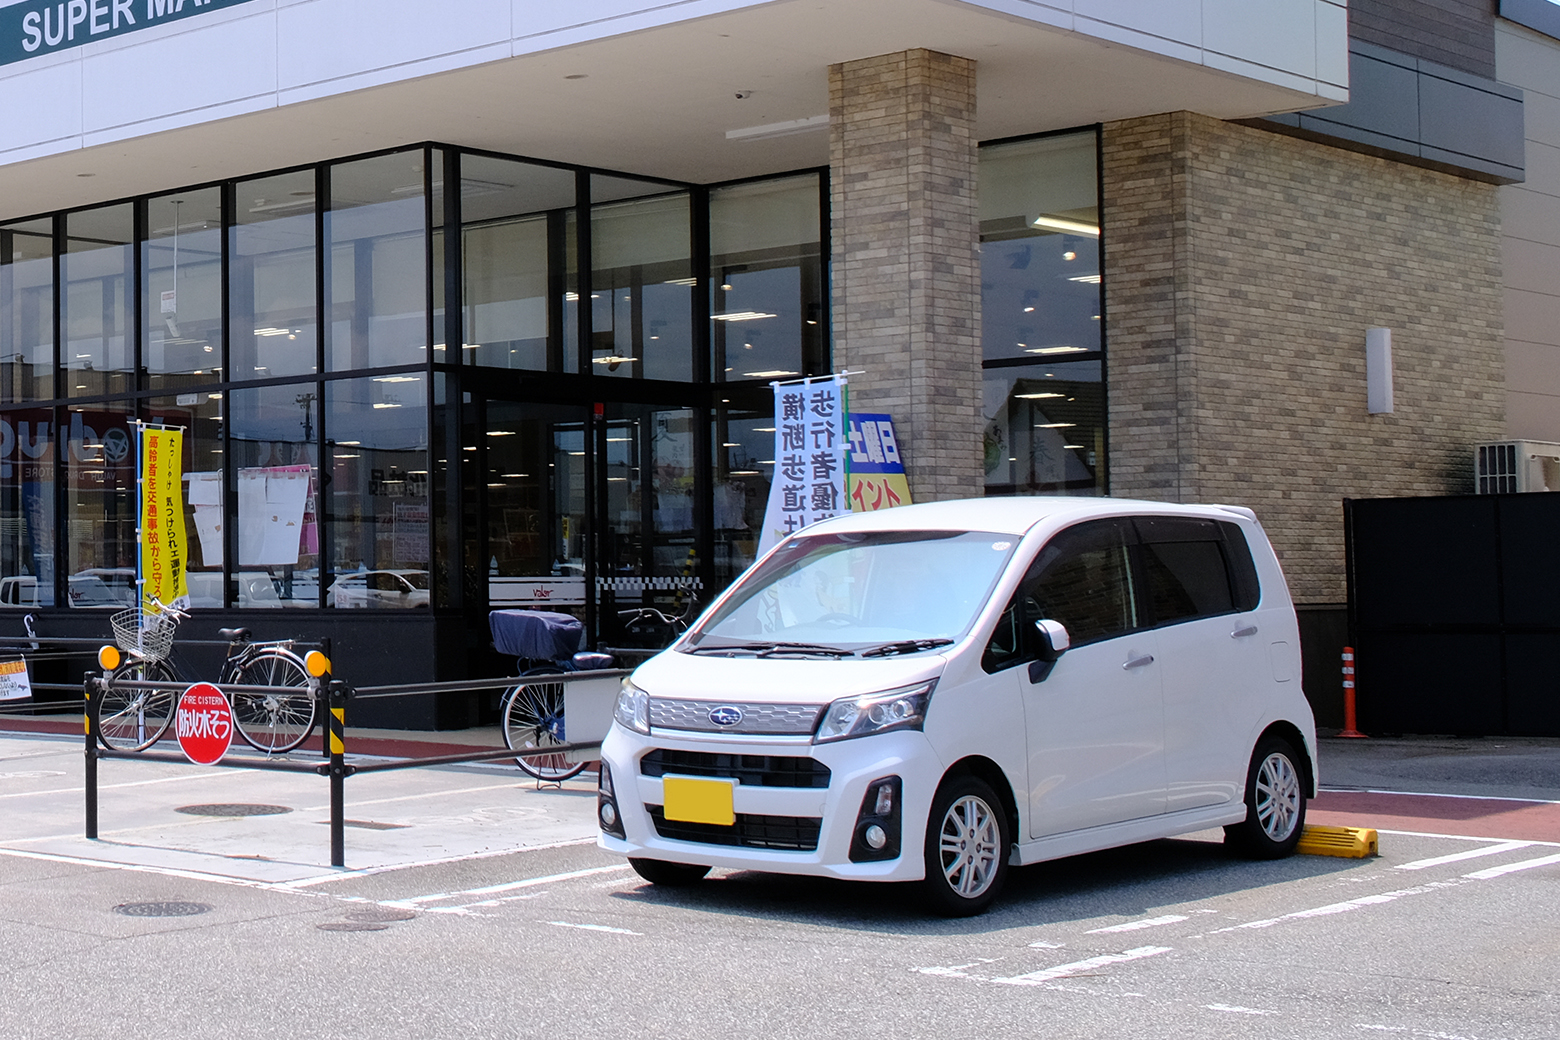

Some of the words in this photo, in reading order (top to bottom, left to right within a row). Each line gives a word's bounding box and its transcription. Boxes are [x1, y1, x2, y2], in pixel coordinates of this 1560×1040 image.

[844, 478, 901, 513] イント
[184, 695, 197, 705] FIRE
[197, 696, 224, 706] CISTERN
[179, 709, 230, 740] 防火水そう
